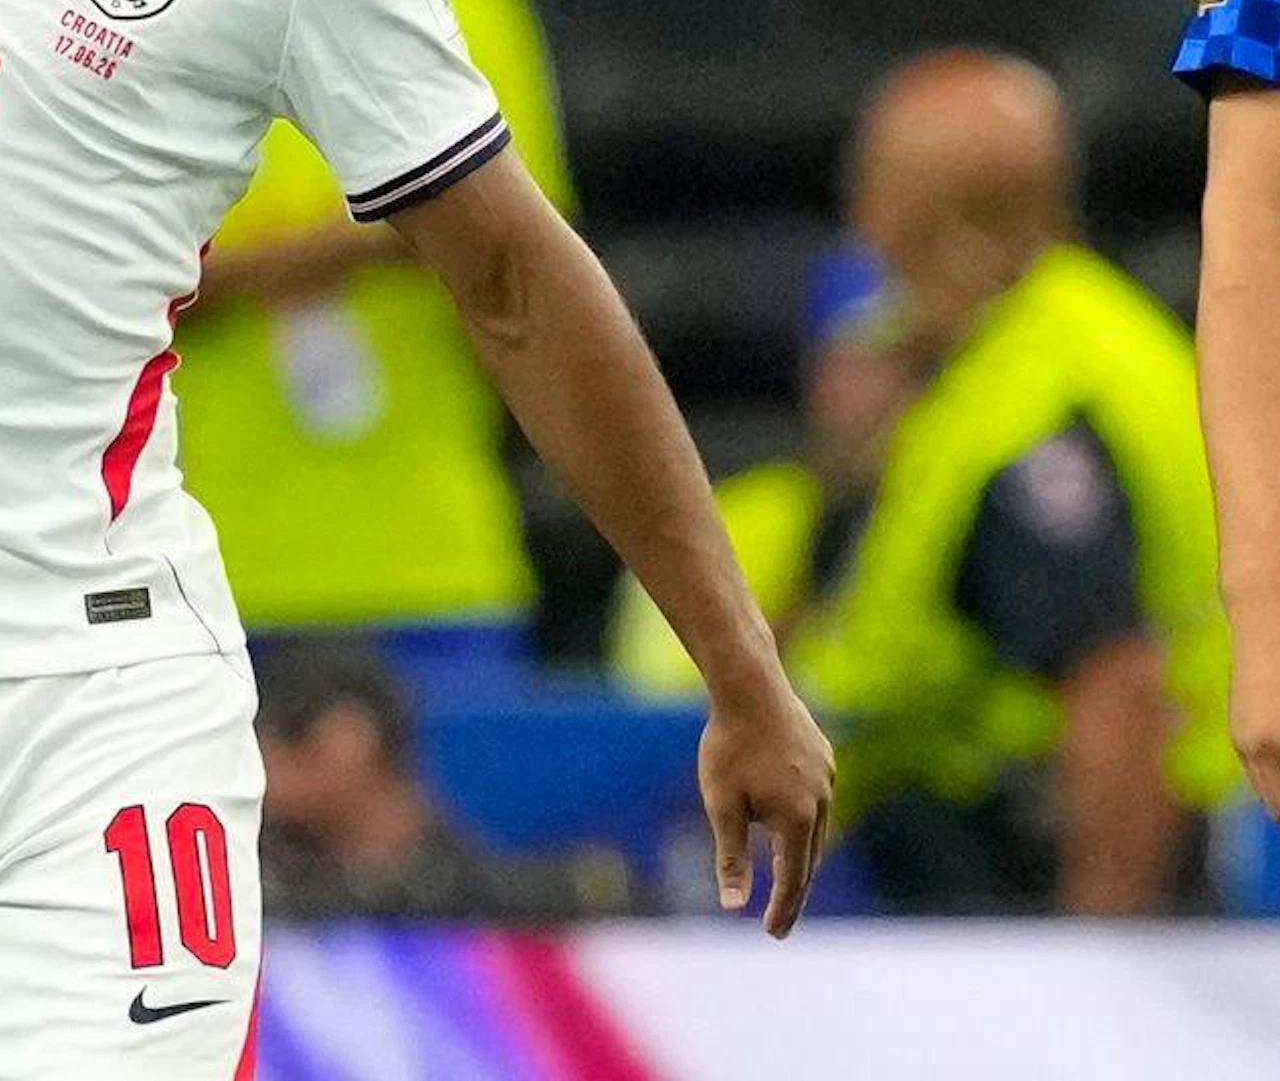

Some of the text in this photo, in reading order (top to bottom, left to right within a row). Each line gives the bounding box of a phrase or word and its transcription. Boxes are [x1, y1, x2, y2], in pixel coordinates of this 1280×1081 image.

[55, 35, 116, 79] 17.06.26
[60, 9, 133, 58] CROATIA
[104, 802, 236, 970] 10
